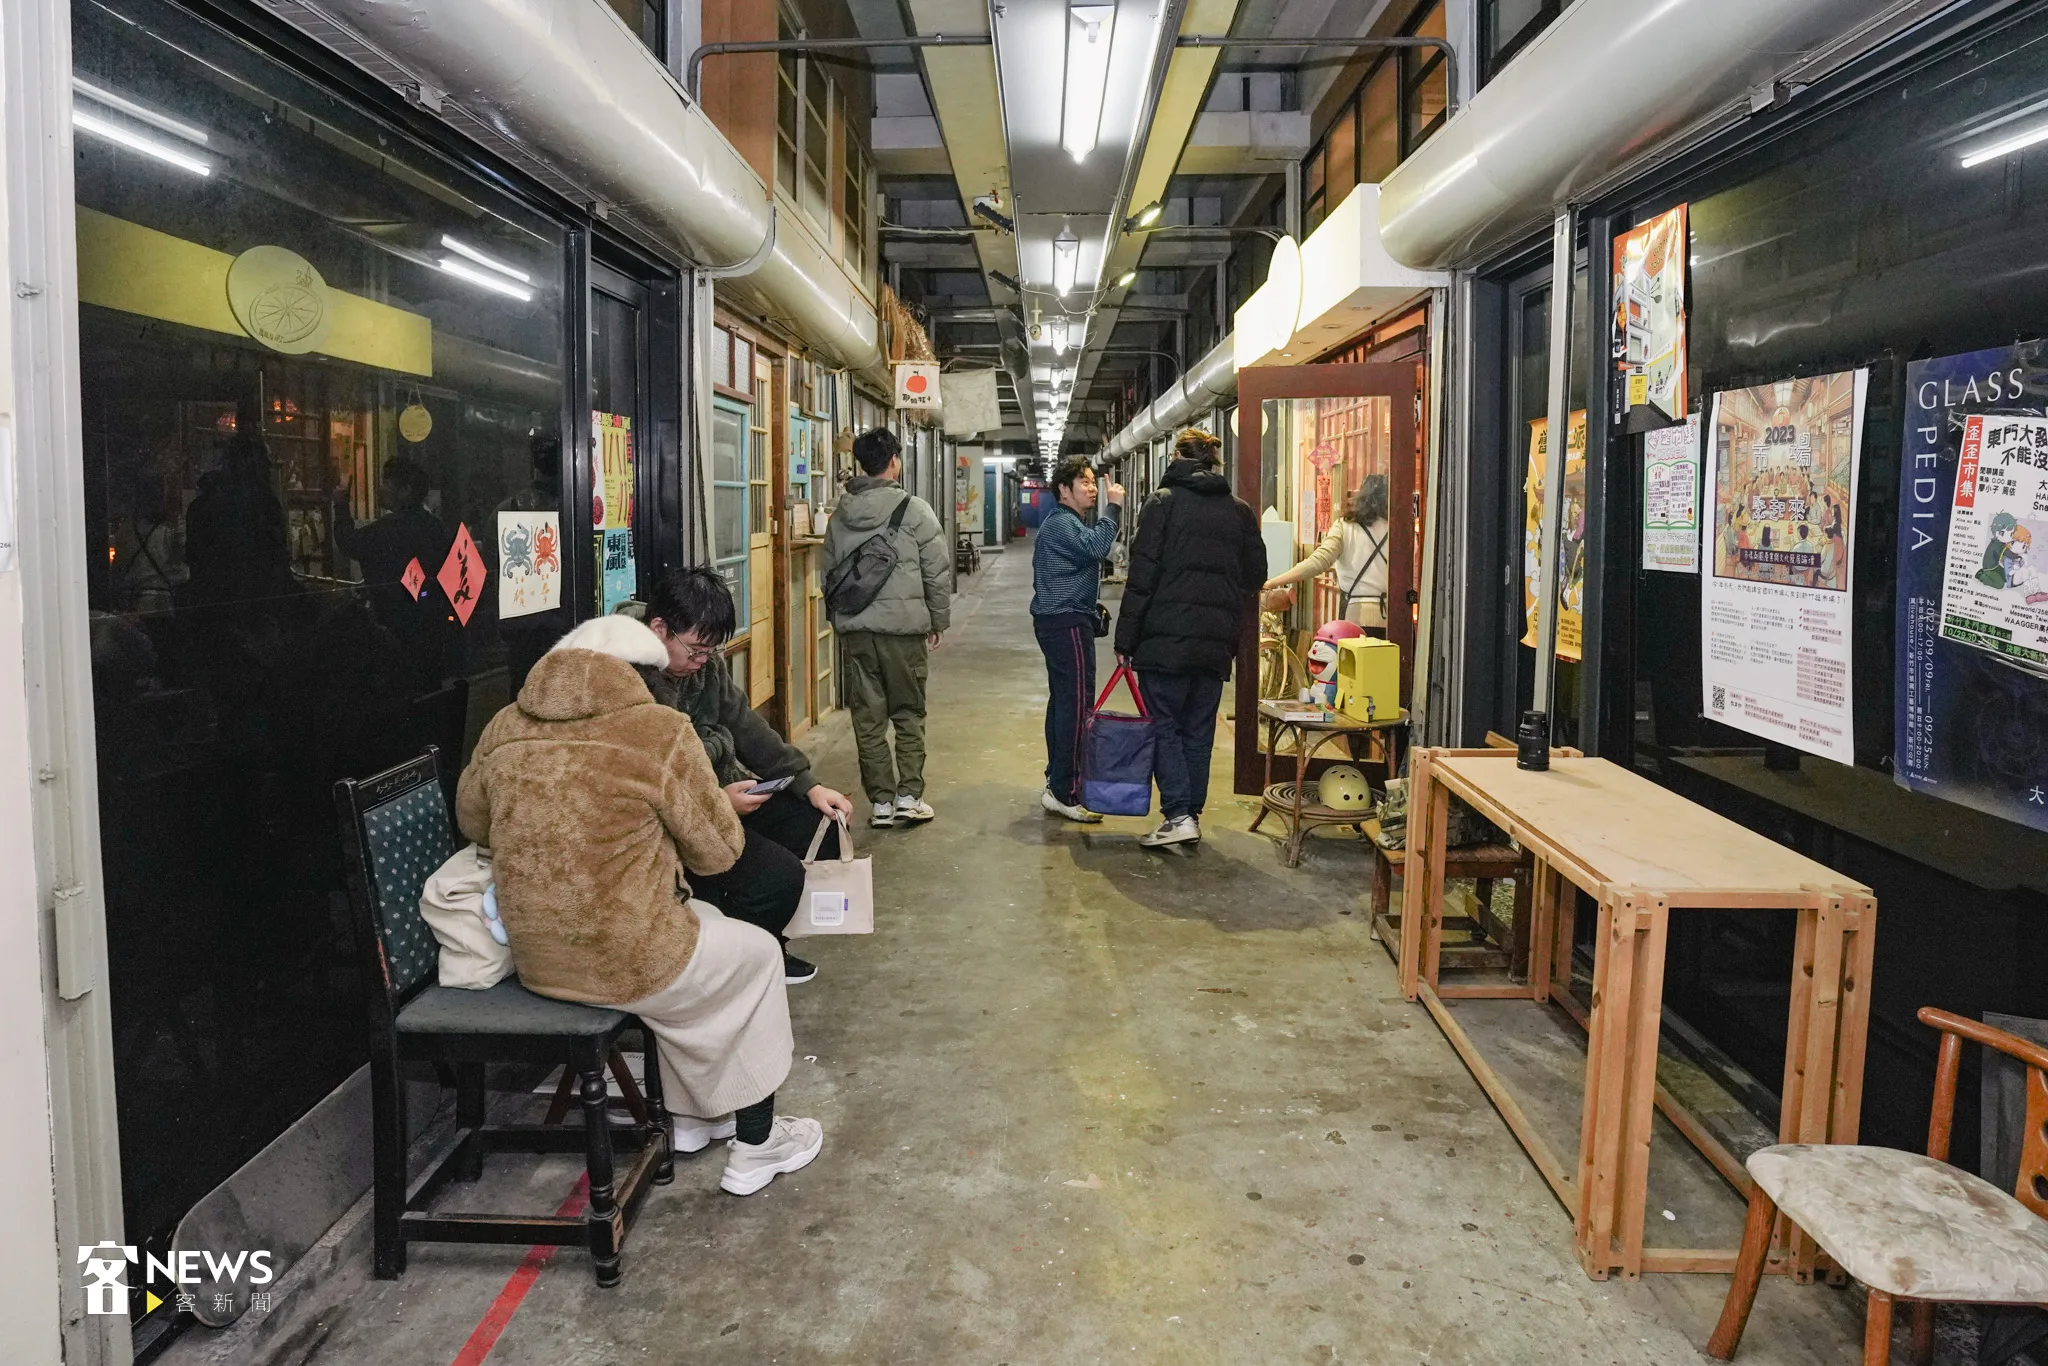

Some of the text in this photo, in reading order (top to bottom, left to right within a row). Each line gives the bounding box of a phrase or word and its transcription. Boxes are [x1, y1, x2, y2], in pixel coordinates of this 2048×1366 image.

[1918, 369, 2023, 409] GLASS
[1752, 432, 1812, 470] 市場
[1765, 425, 1795, 445] 2023
[1960, 425, 1981, 498] 歪歪市集
[1911, 426, 1937, 551] PEDIA
[2029, 785, 2045, 805] 大
